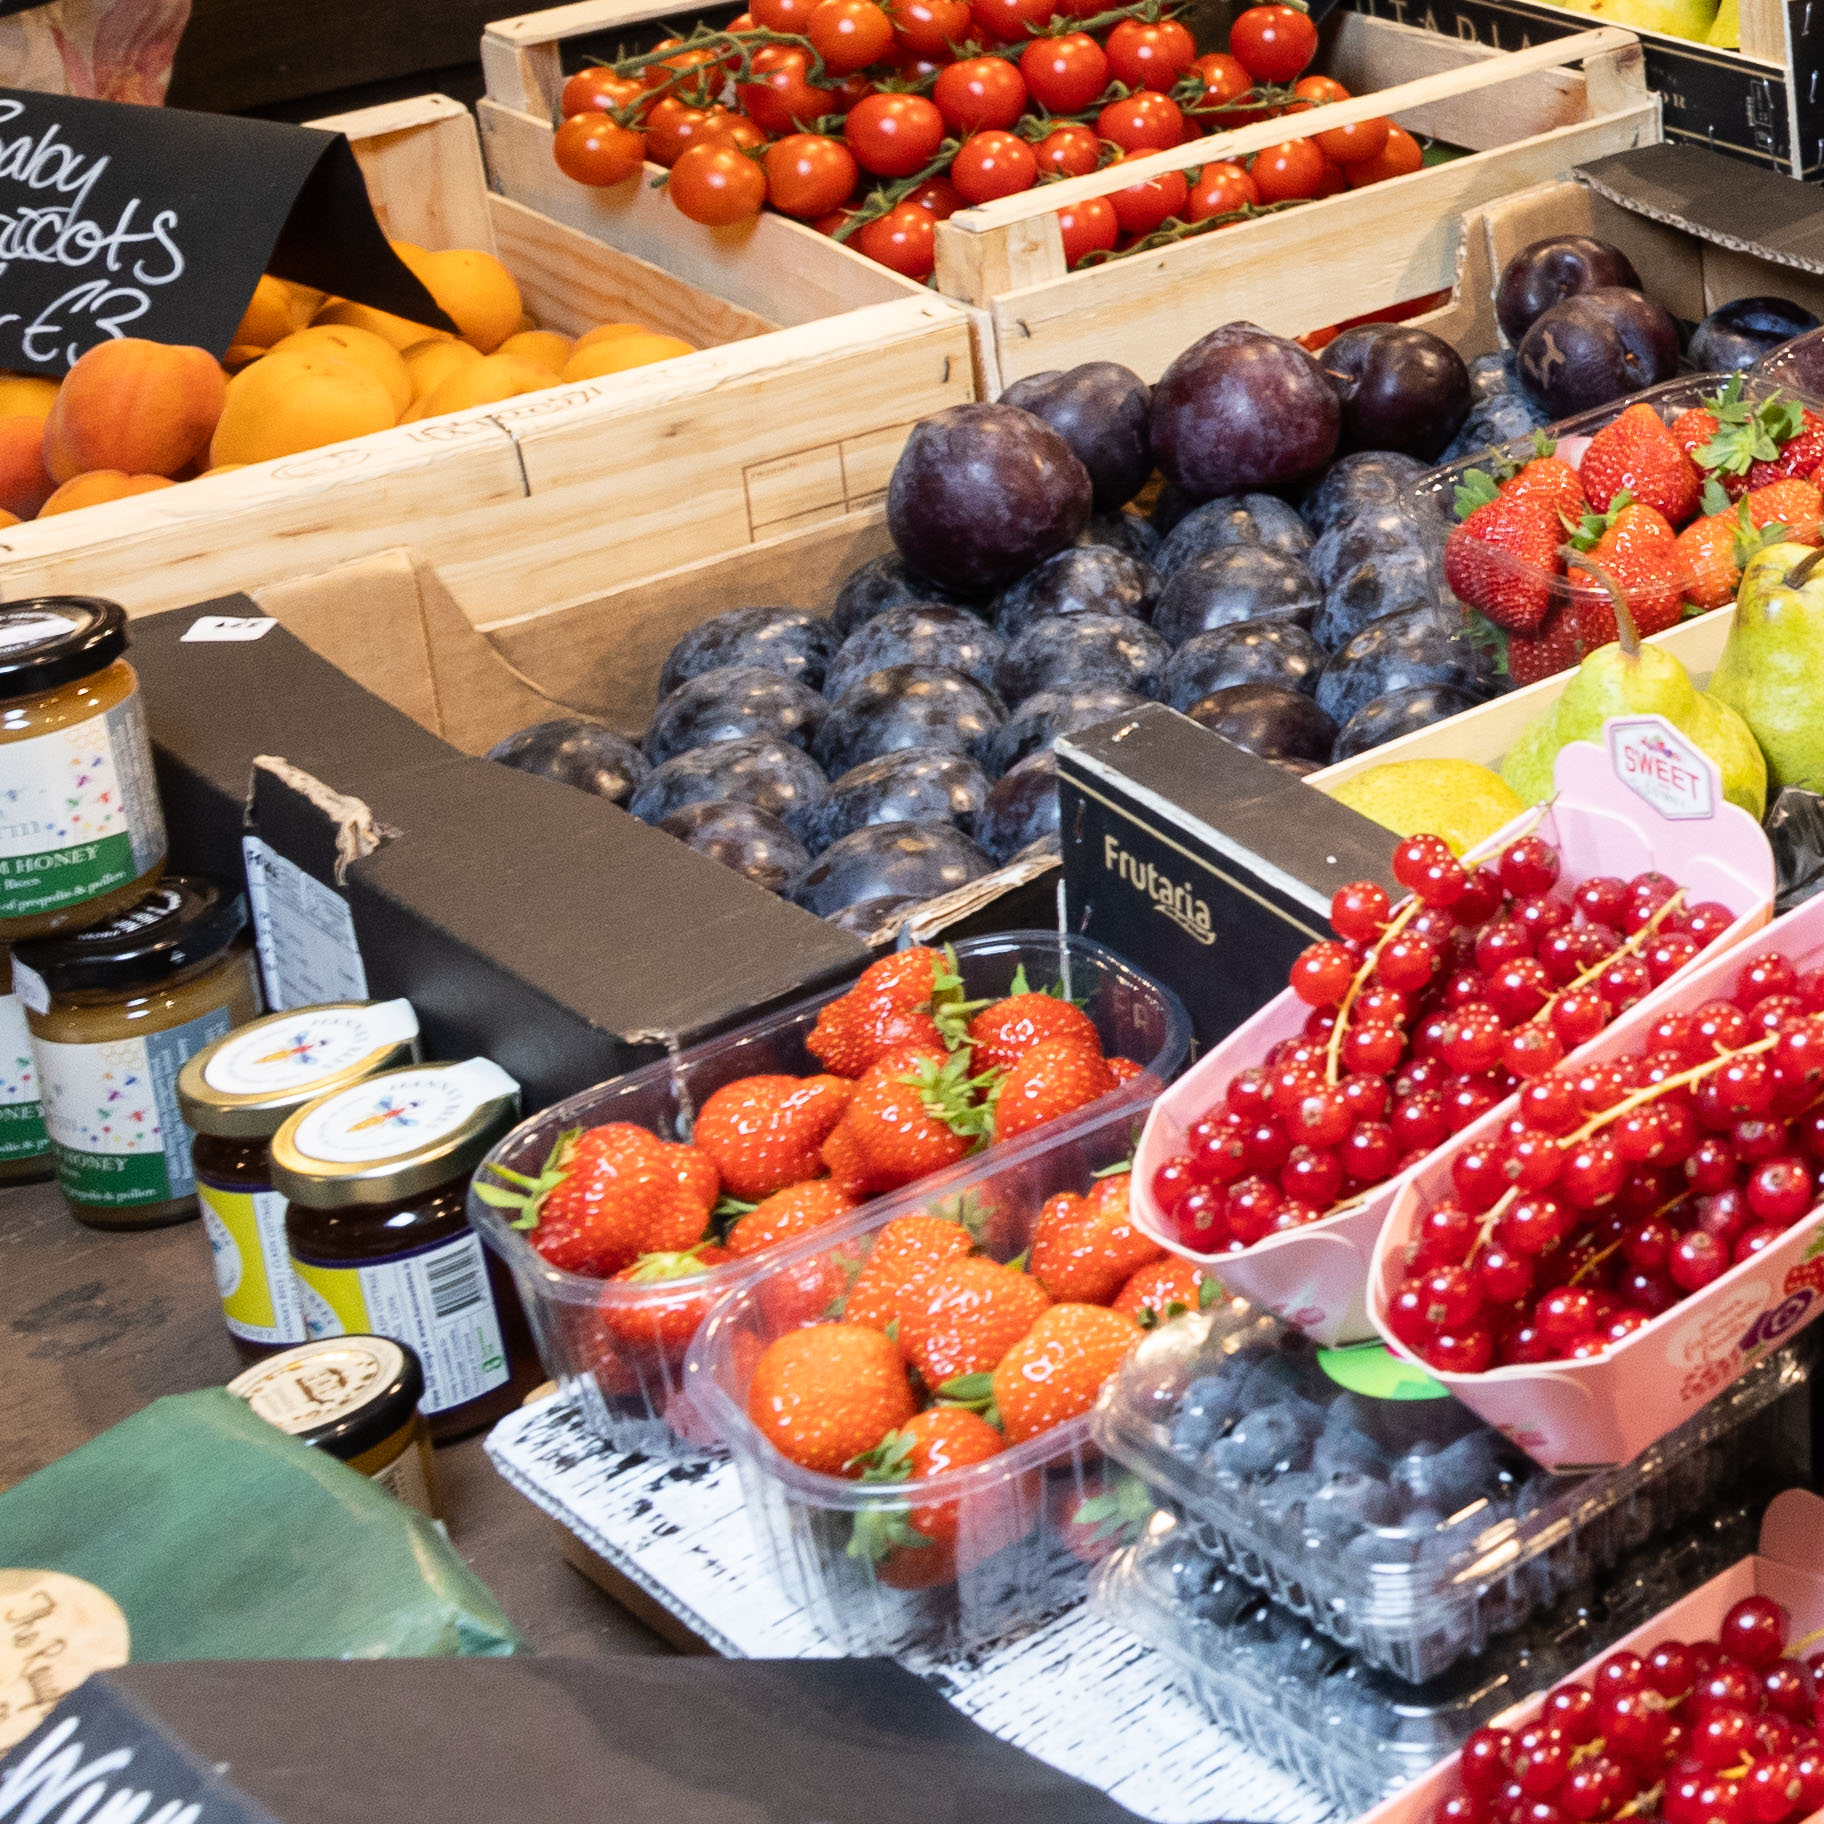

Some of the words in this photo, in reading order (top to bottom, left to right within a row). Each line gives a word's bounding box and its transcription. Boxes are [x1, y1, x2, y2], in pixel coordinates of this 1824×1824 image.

[1624, 745, 1699, 801] SWEET
[24, 843, 99, 875] HONEY
[1103, 832, 1217, 946] Frutaria
[0, 1104, 43, 1120] ONEY
